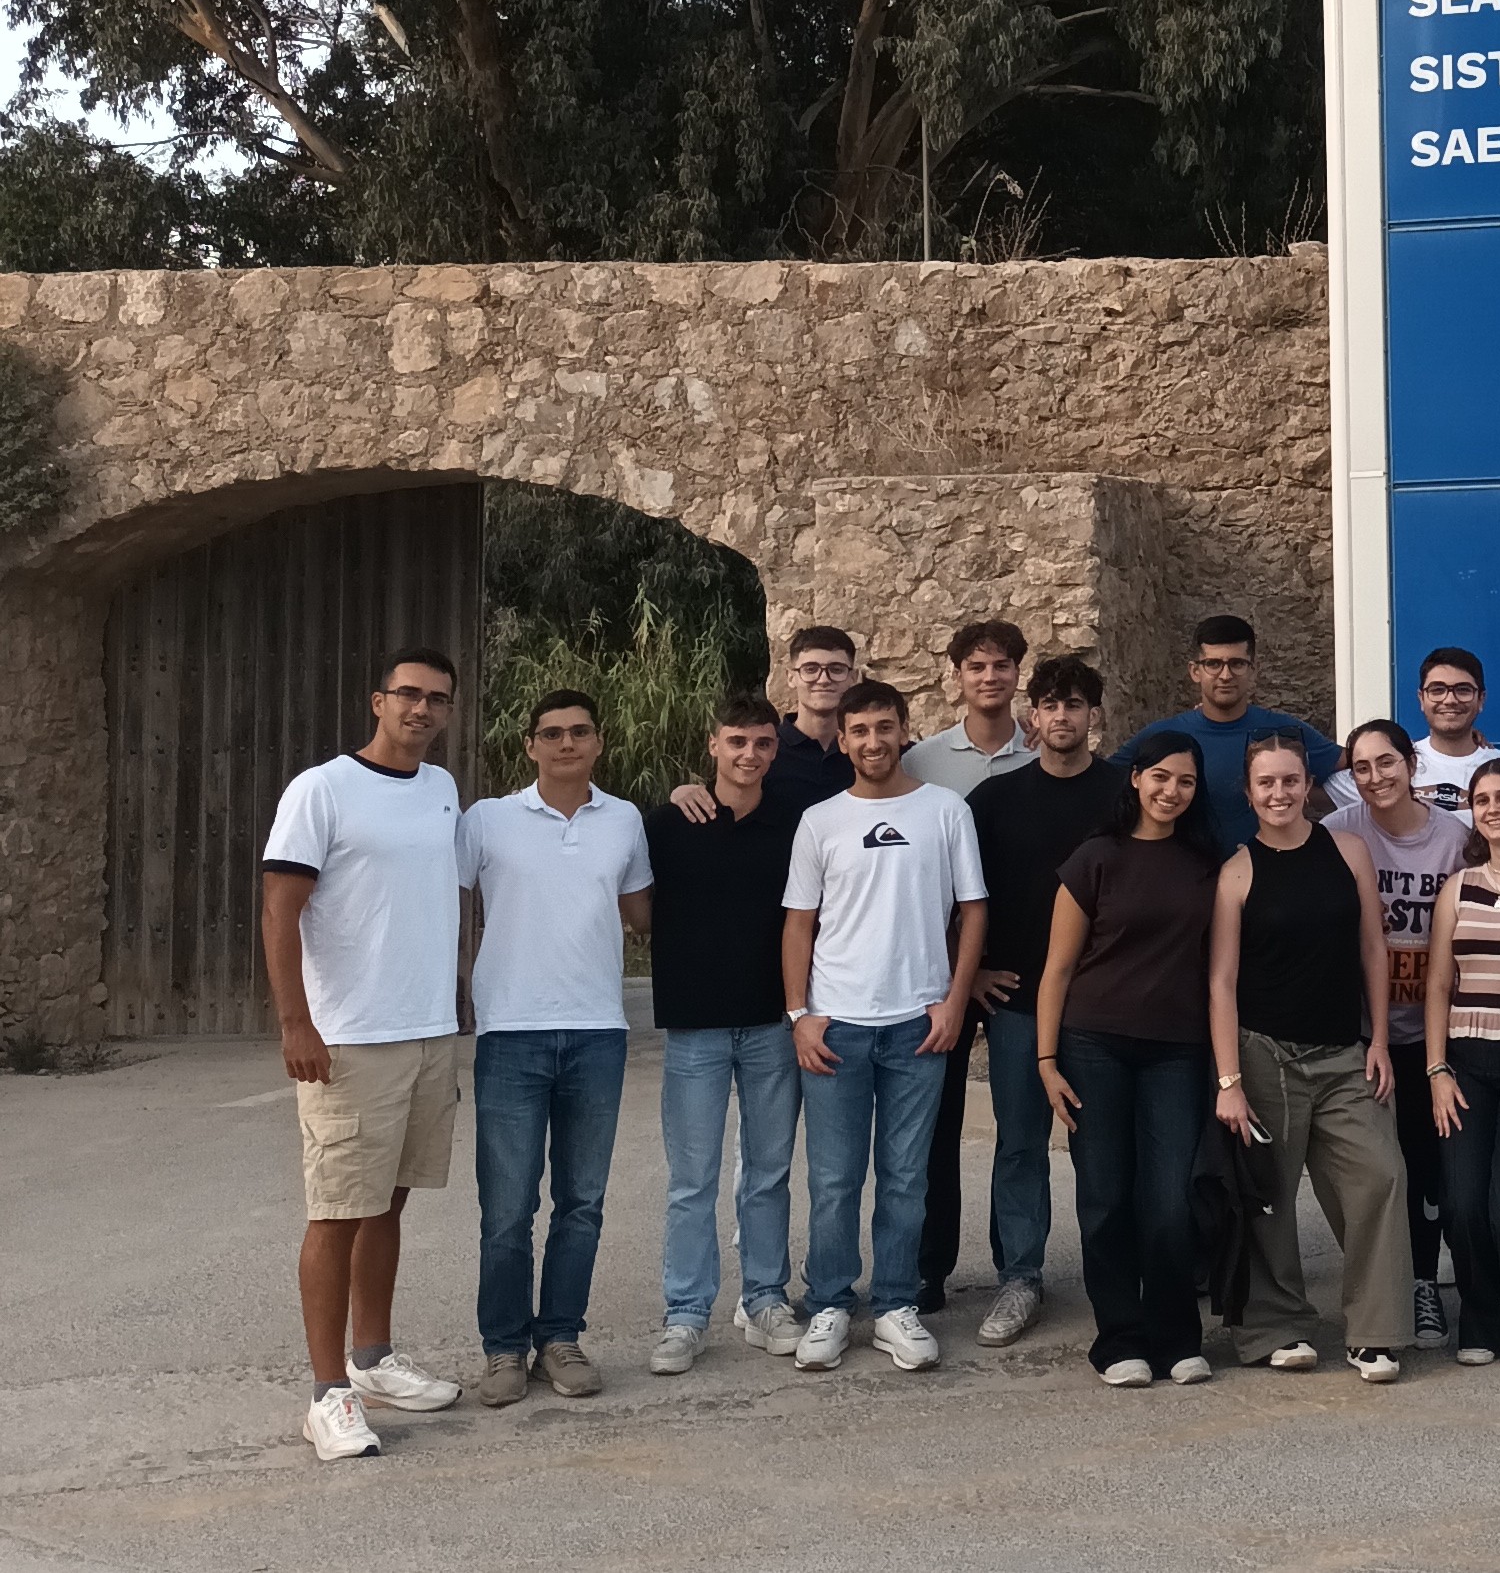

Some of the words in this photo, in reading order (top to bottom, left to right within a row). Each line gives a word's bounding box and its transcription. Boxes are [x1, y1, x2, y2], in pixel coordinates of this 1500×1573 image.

[1377, 869, 1415, 896] N'T
[1387, 898, 1435, 934] ST
[1388, 950, 1430, 981] EP
